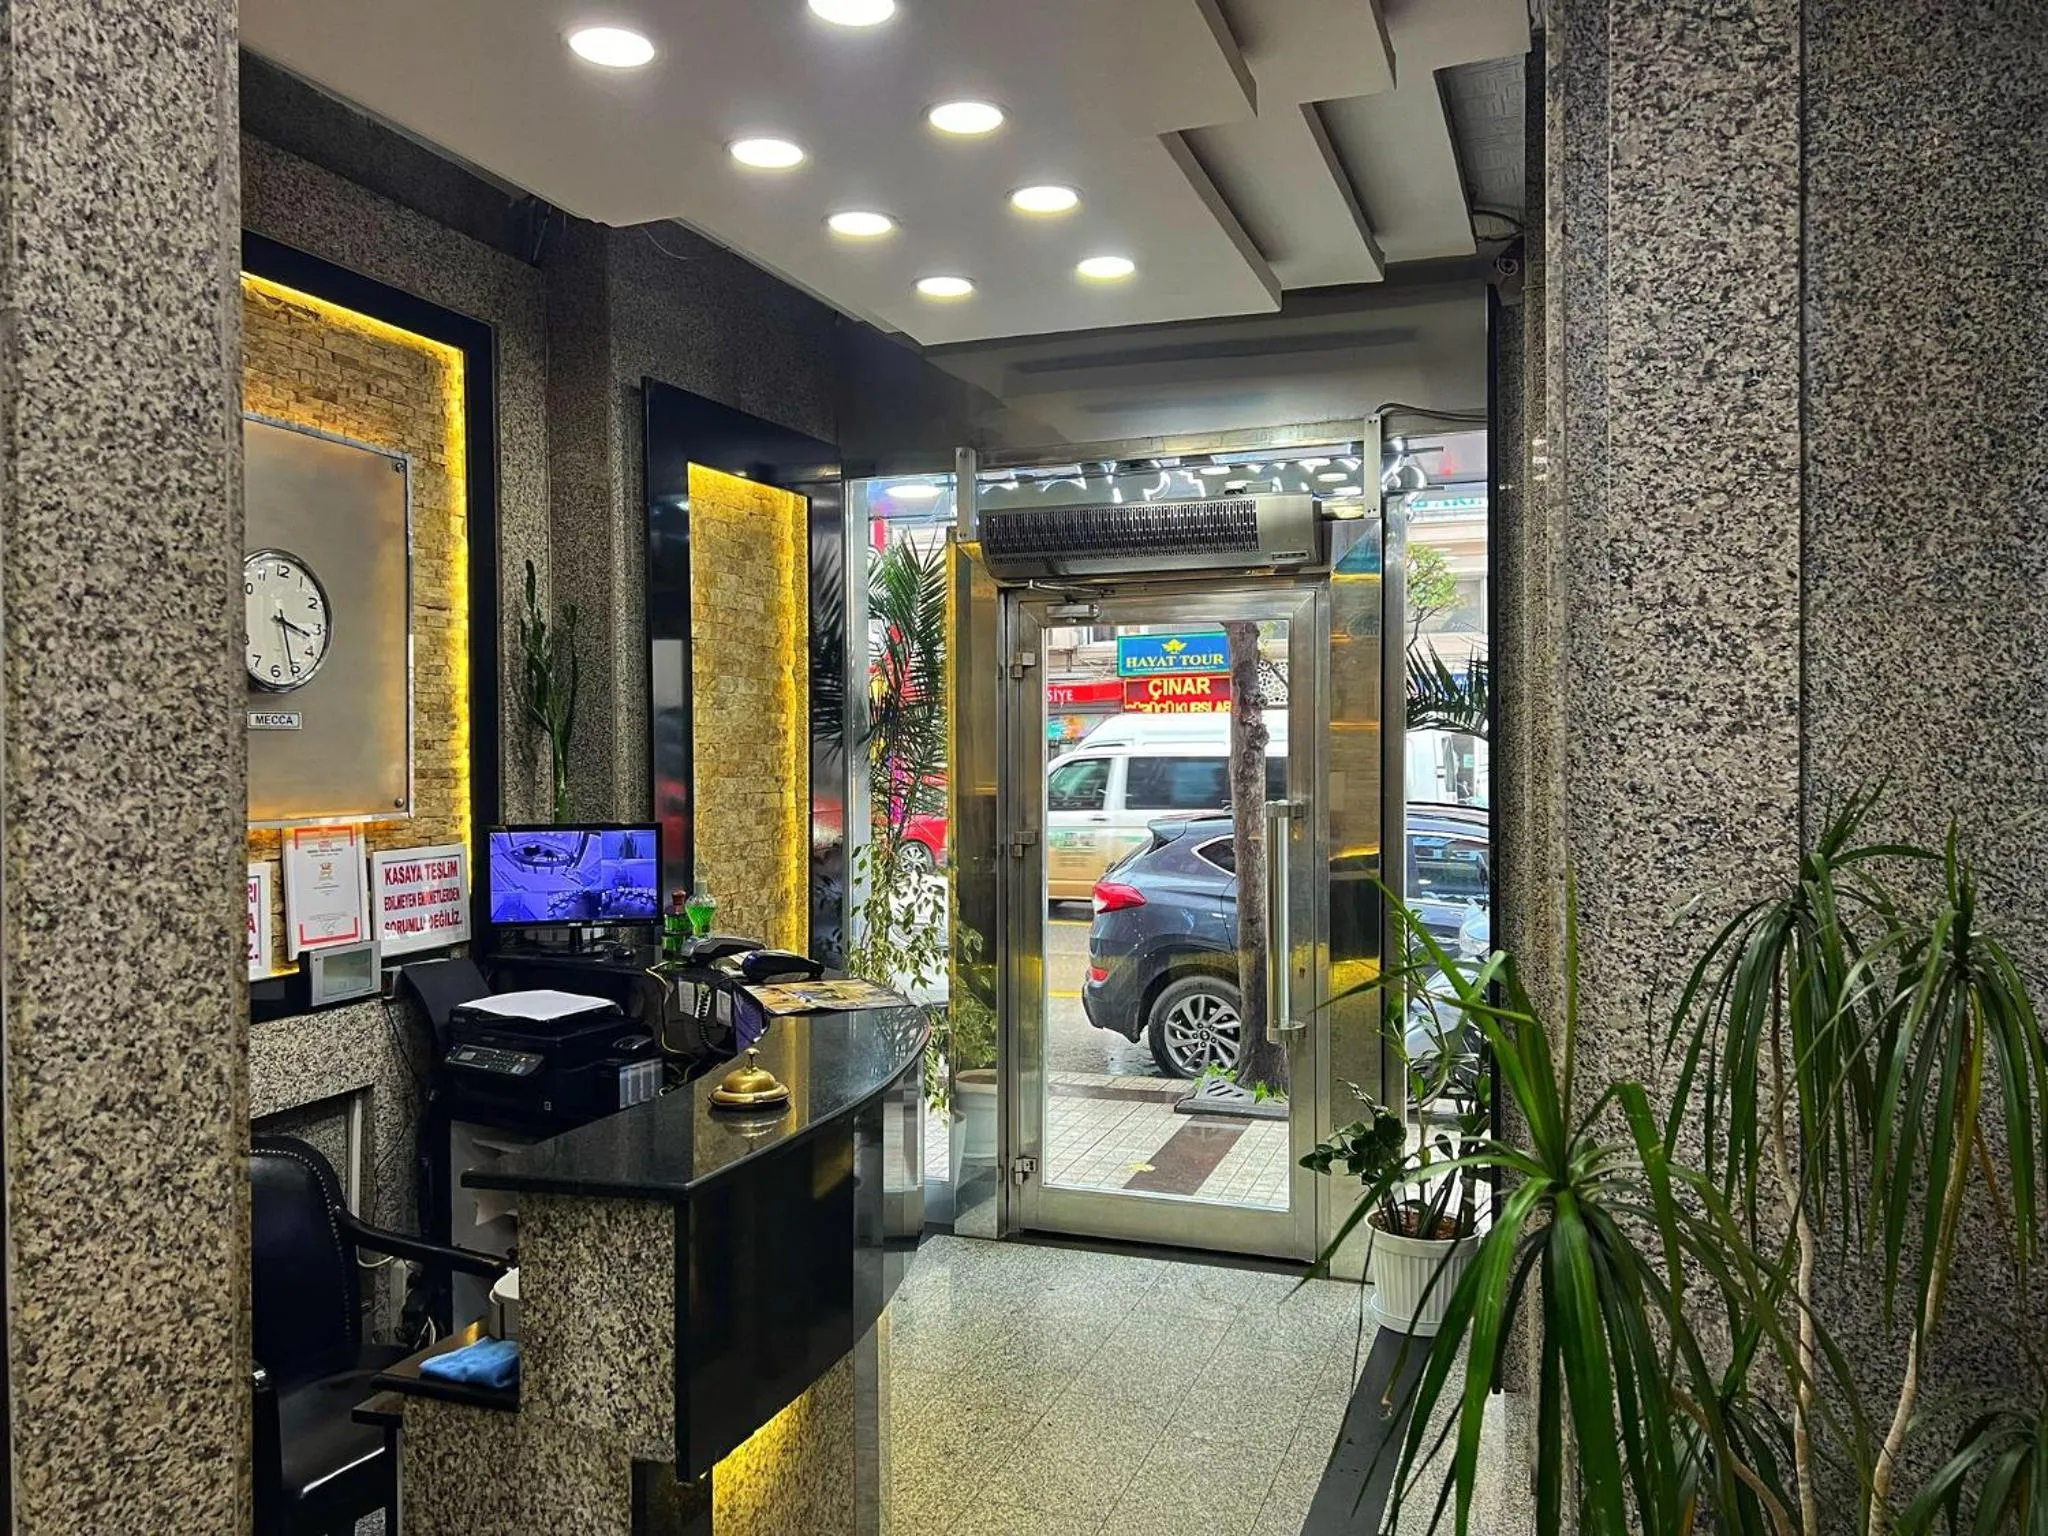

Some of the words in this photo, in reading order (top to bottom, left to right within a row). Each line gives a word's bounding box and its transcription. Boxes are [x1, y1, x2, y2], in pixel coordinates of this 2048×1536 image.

[276, 564, 290, 579] 12
[308, 597, 318, 610] 2
[313, 623, 322, 636] 3
[305, 645, 314, 658] 4
[252, 654, 262, 668] 7
[1126, 656, 1177, 668] HAYAT
[1179, 653, 1225, 666] TOUR
[270, 664, 281, 678] 6
[1148, 677, 1212, 700] ÇINAR
[255, 715, 293, 725] MECCA
[384, 865, 423, 886] KASAYA
[424, 860, 458, 880] TESLİM
